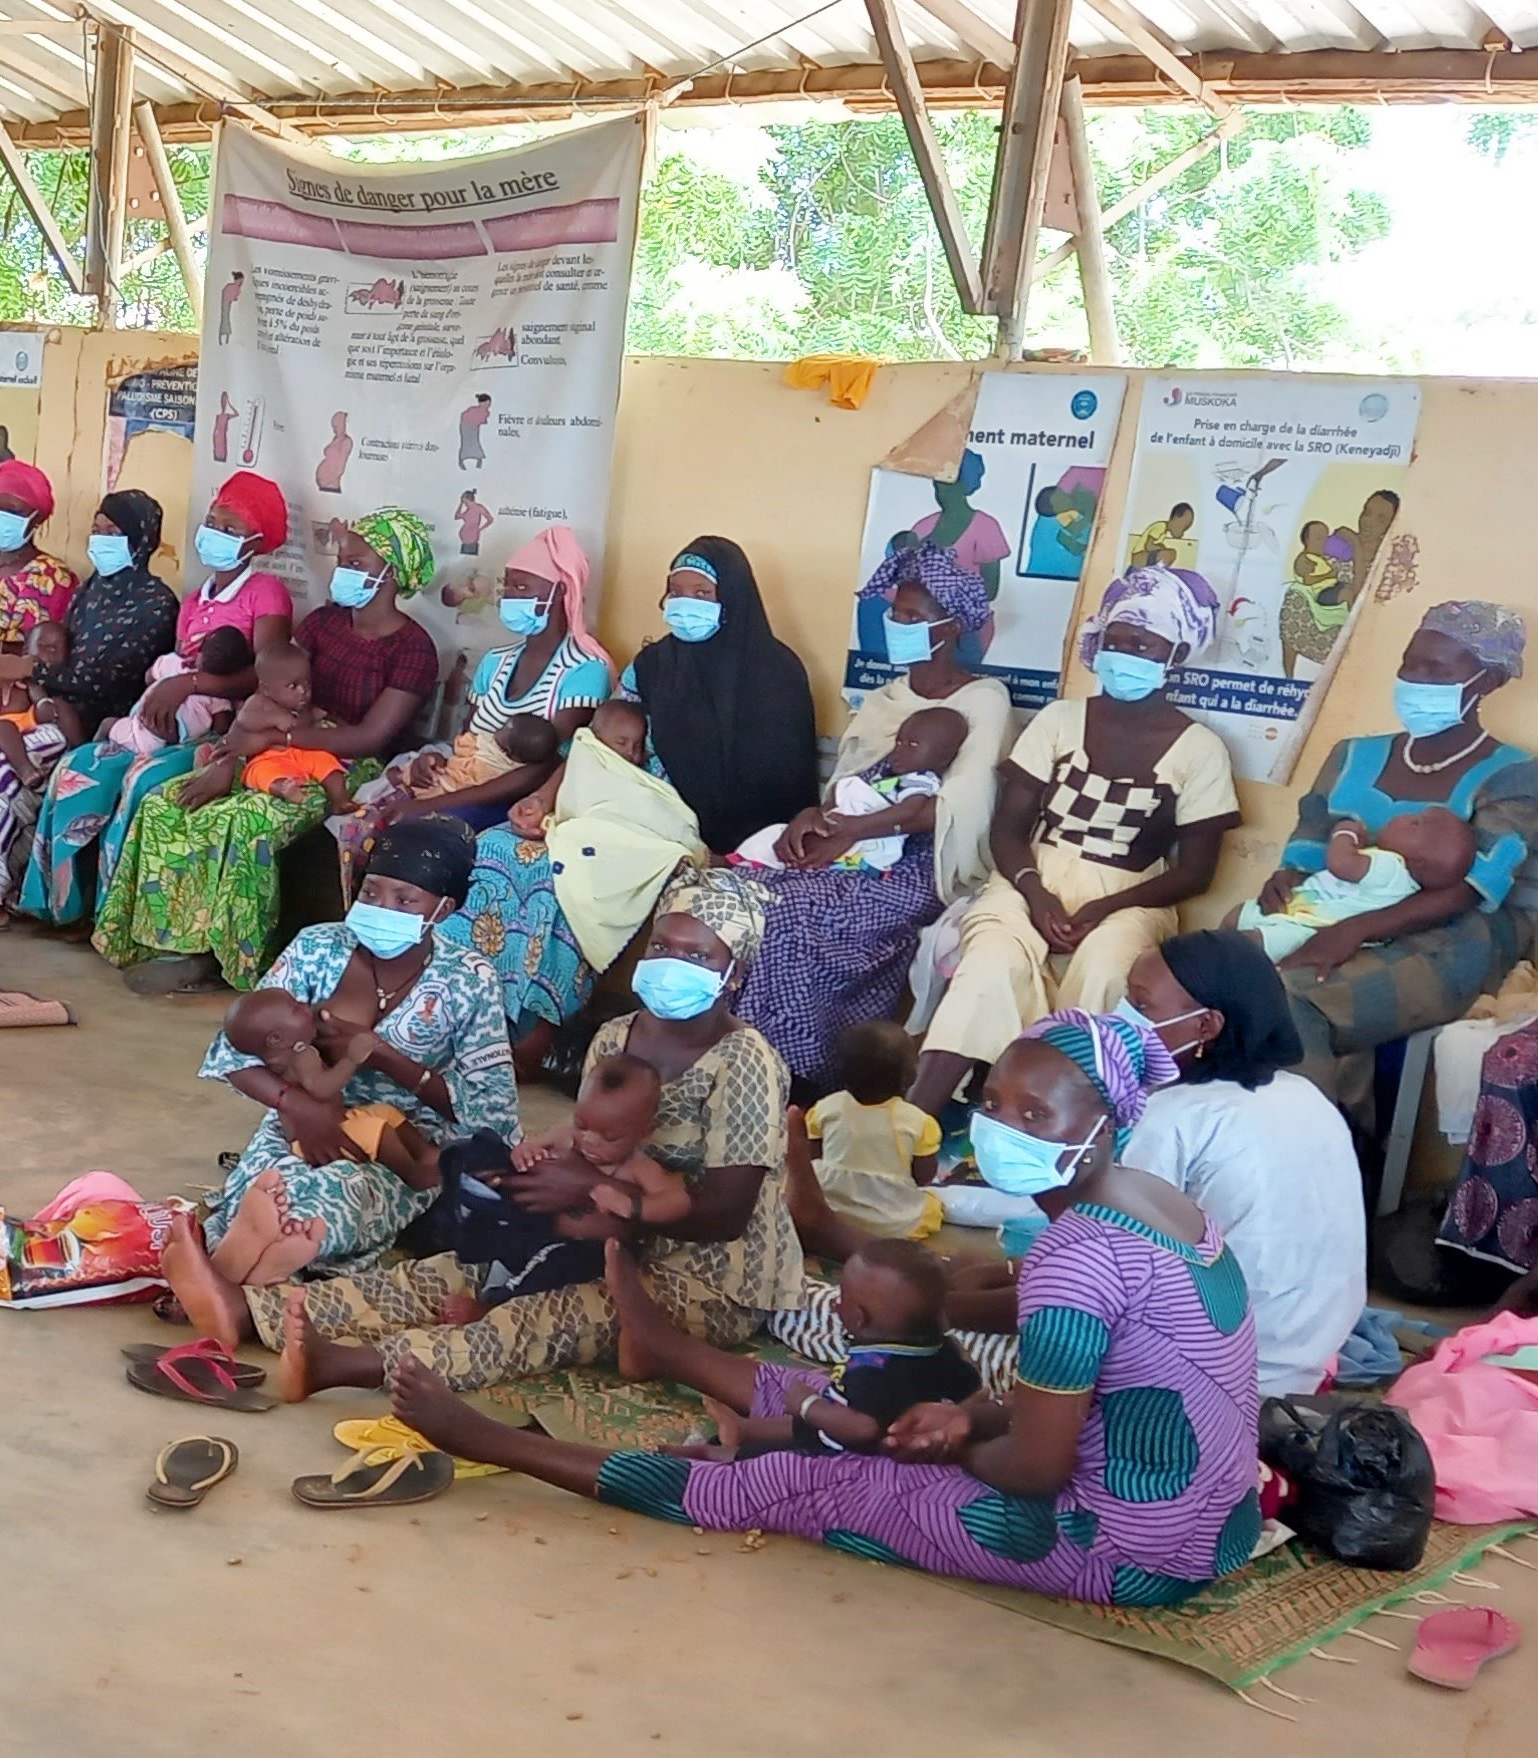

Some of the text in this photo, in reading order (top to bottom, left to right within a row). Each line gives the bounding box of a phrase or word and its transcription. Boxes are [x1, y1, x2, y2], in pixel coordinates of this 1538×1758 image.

[286, 168, 558, 213] Signes de danger pour la mère
[152, 380, 198, 391] PREVENTIO
[164, 393, 196, 406] SAISON
[1184, 397, 1238, 408] MUSKOKA
[149, 408, 179, 421] (CPS)
[1193, 418, 1358, 437] Prise en charge de la diarrhée
[1010, 430, 1095, 449] maternel
[1150, 431, 1163, 443] de
[1166, 432, 1207, 446] l'enfant
[1208, 435, 1216, 447] à
[1218, 435, 1263, 449] domicile
[1266, 439, 1292, 451] avec
[1294, 438, 1304, 451] la
[1307, 441, 1332, 454] SRO
[1183, 671, 1210, 687] SRO
[1211, 677, 1256, 693] permet
[1258, 681, 1275, 695] de
[1165, 689, 1300, 718] nfant qui a la diarrhée.
